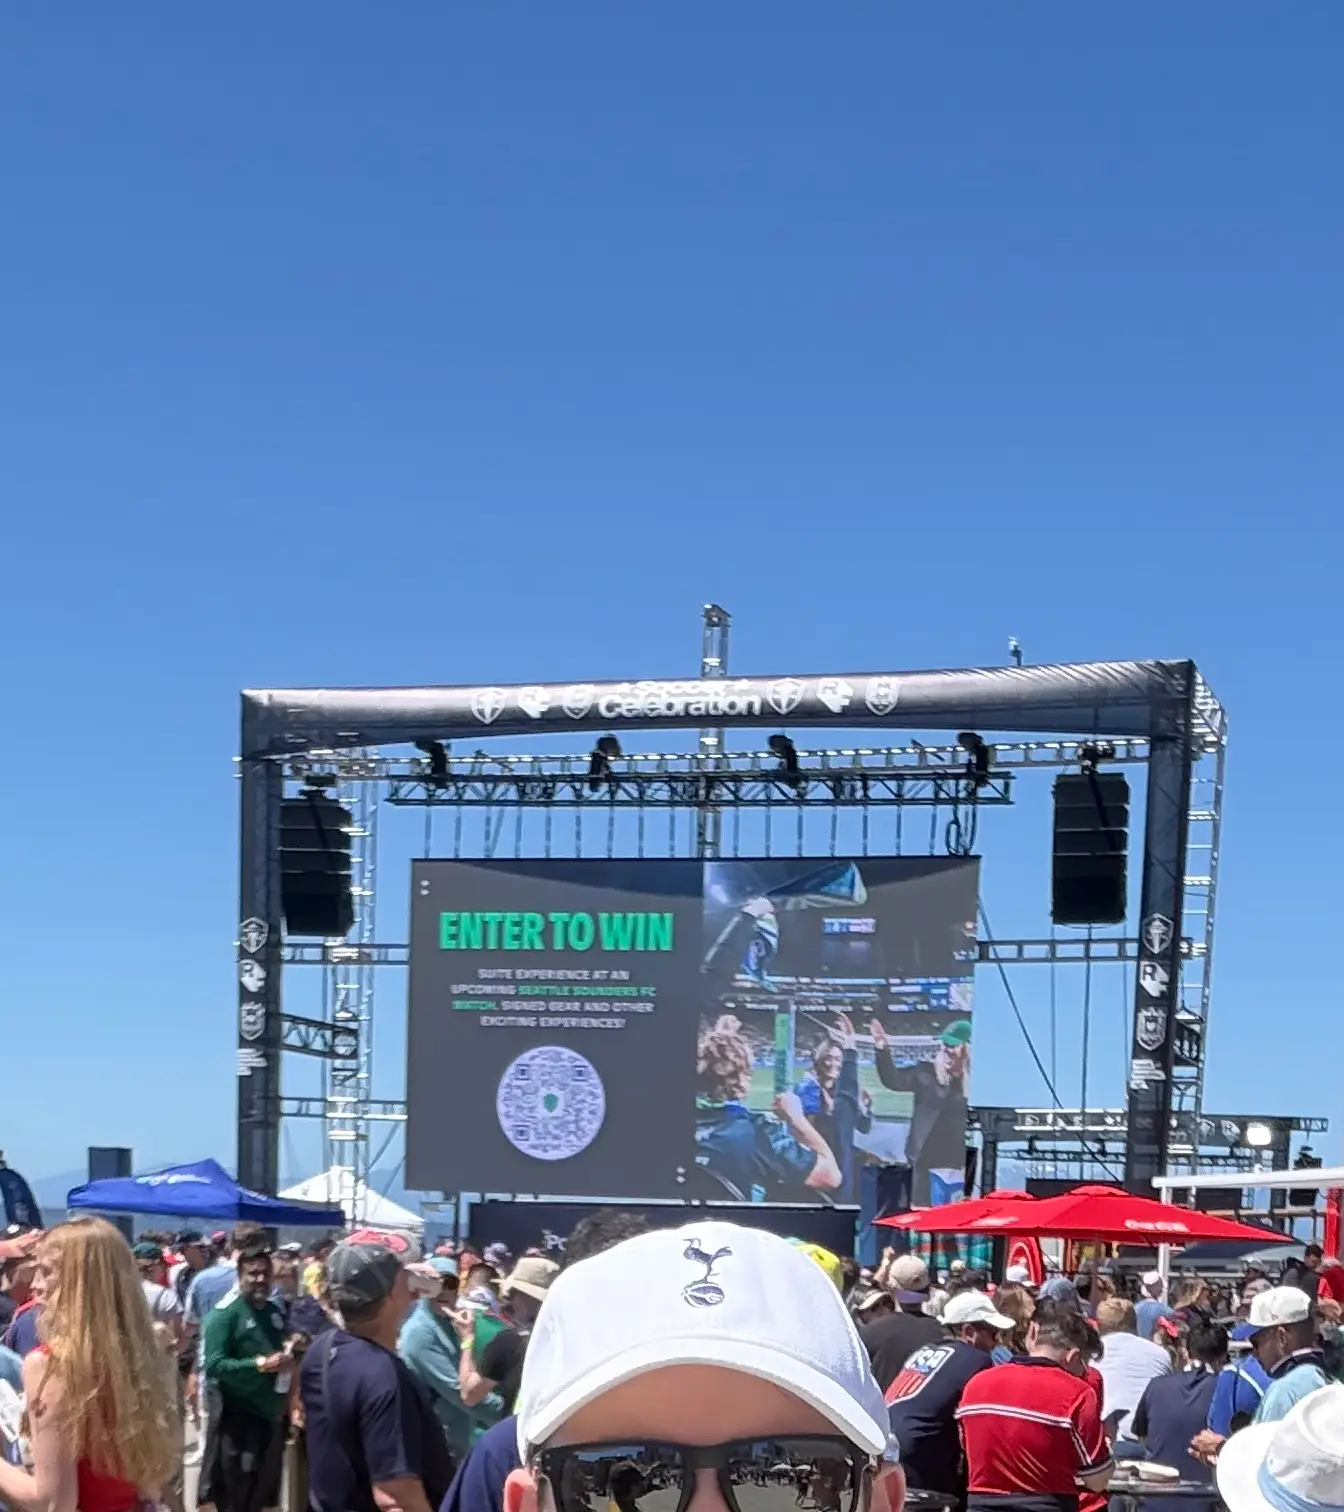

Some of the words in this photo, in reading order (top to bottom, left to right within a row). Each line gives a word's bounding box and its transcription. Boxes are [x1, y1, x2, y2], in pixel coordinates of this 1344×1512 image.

[598, 692, 762, 719] Celebration
[439, 912, 545, 950] ENTER
[549, 912, 595, 950] TO
[598, 912, 673, 950] WIN
[515, 968, 590, 981] EXPERIENCE
[592, 969, 609, 981] AT
[610, 969, 630, 981] AN
[450, 984, 516, 995] UPCOMING
[640, 986, 657, 998] FC
[583, 1002, 611, 1012] AND
[612, 1002, 655, 1013] OTHER
